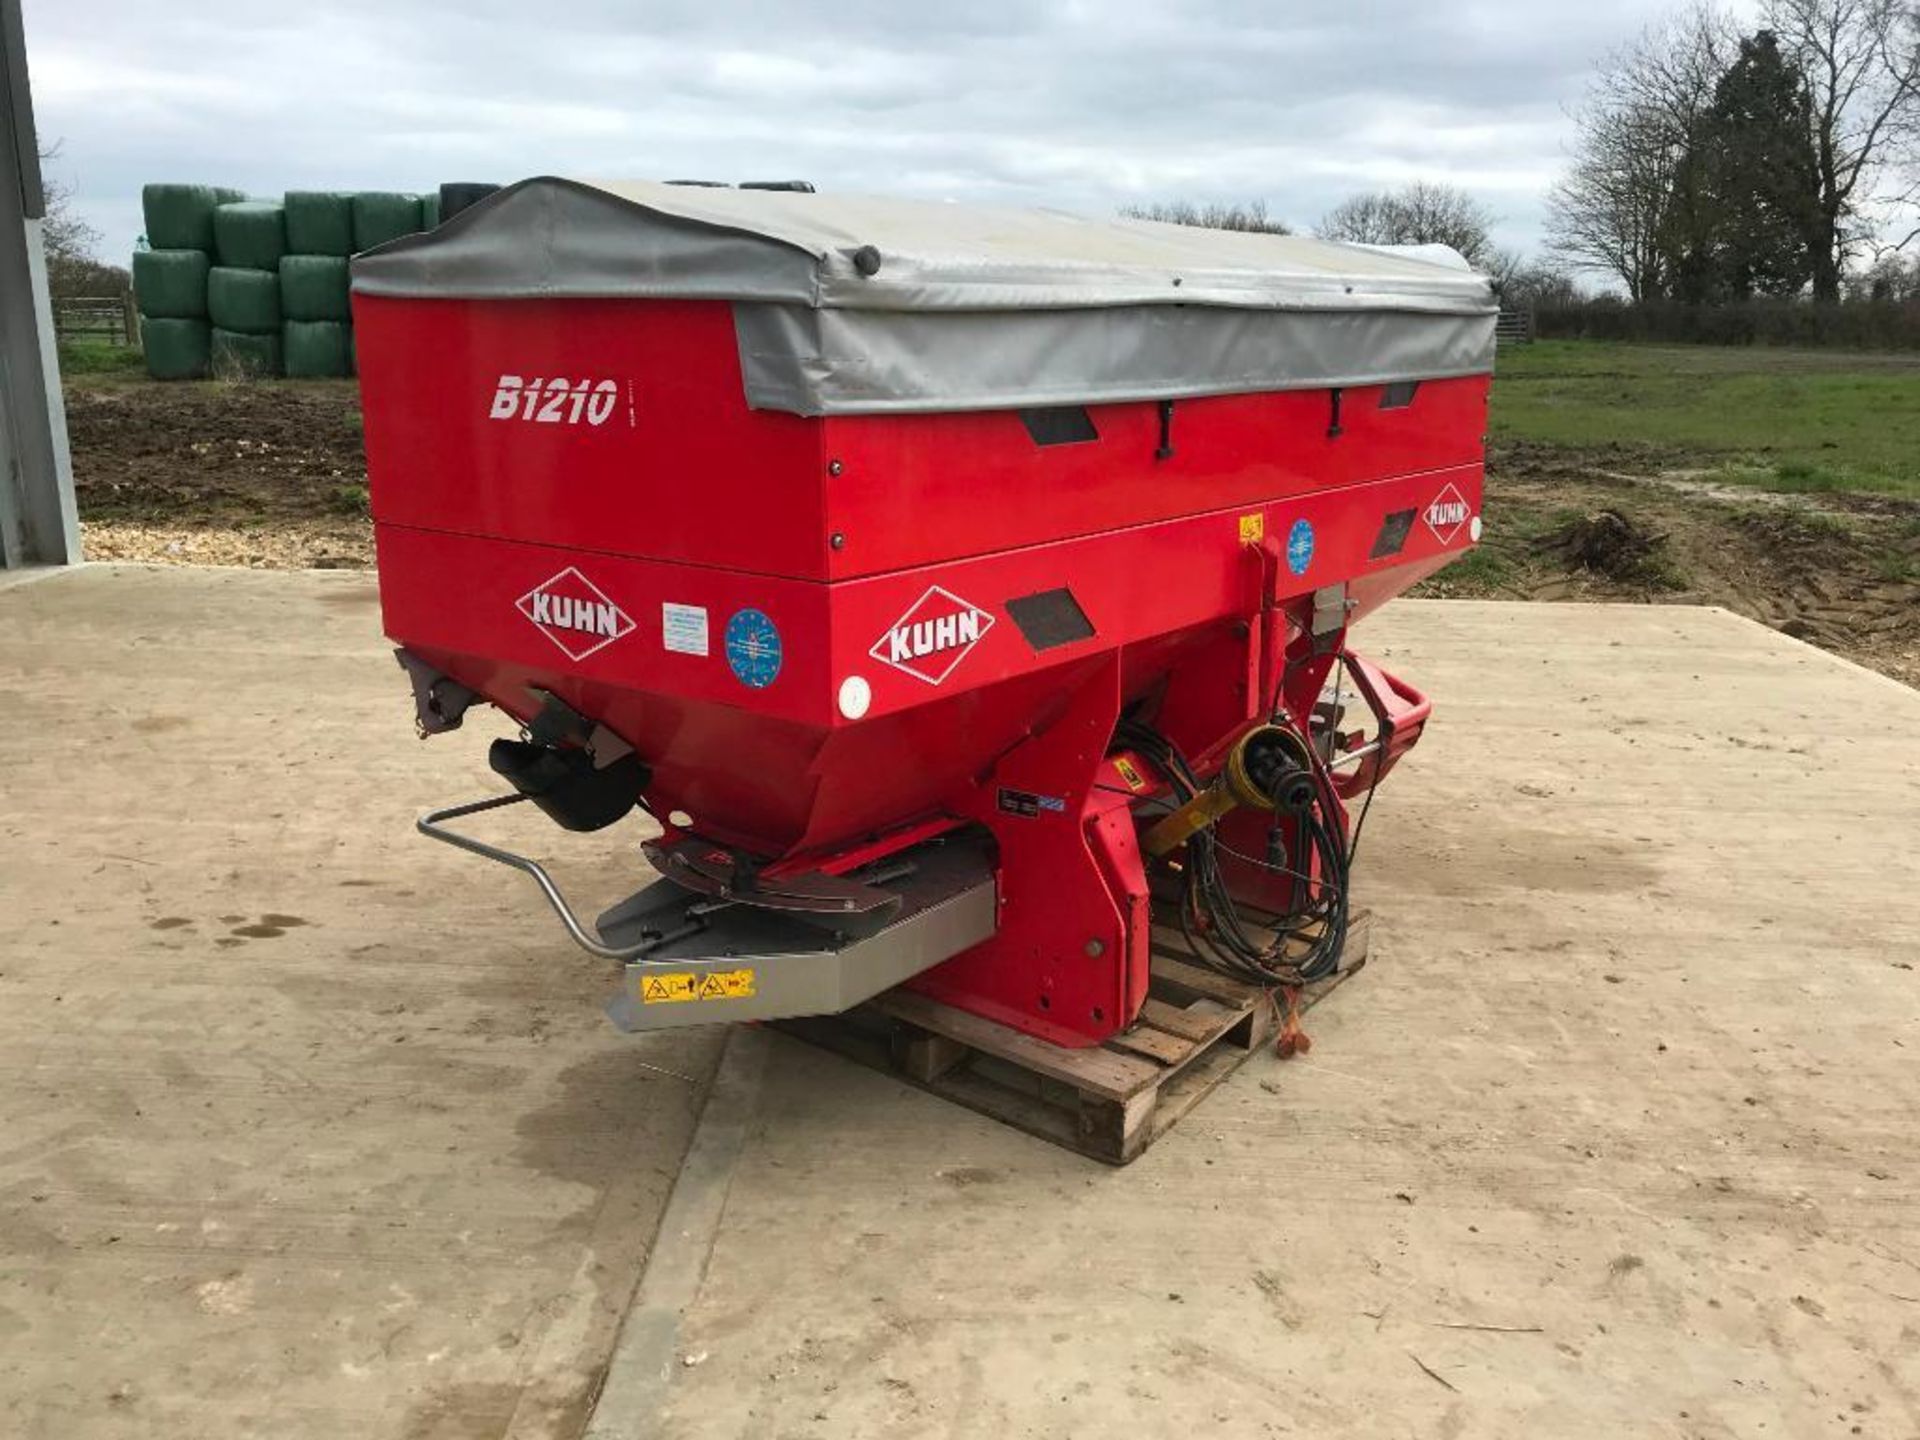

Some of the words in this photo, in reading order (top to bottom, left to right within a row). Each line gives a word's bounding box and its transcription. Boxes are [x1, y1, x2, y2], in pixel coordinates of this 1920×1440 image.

[489, 375, 617, 426] B1210
[532, 592, 617, 638] KUHN
[890, 609, 979, 664] KUHN
